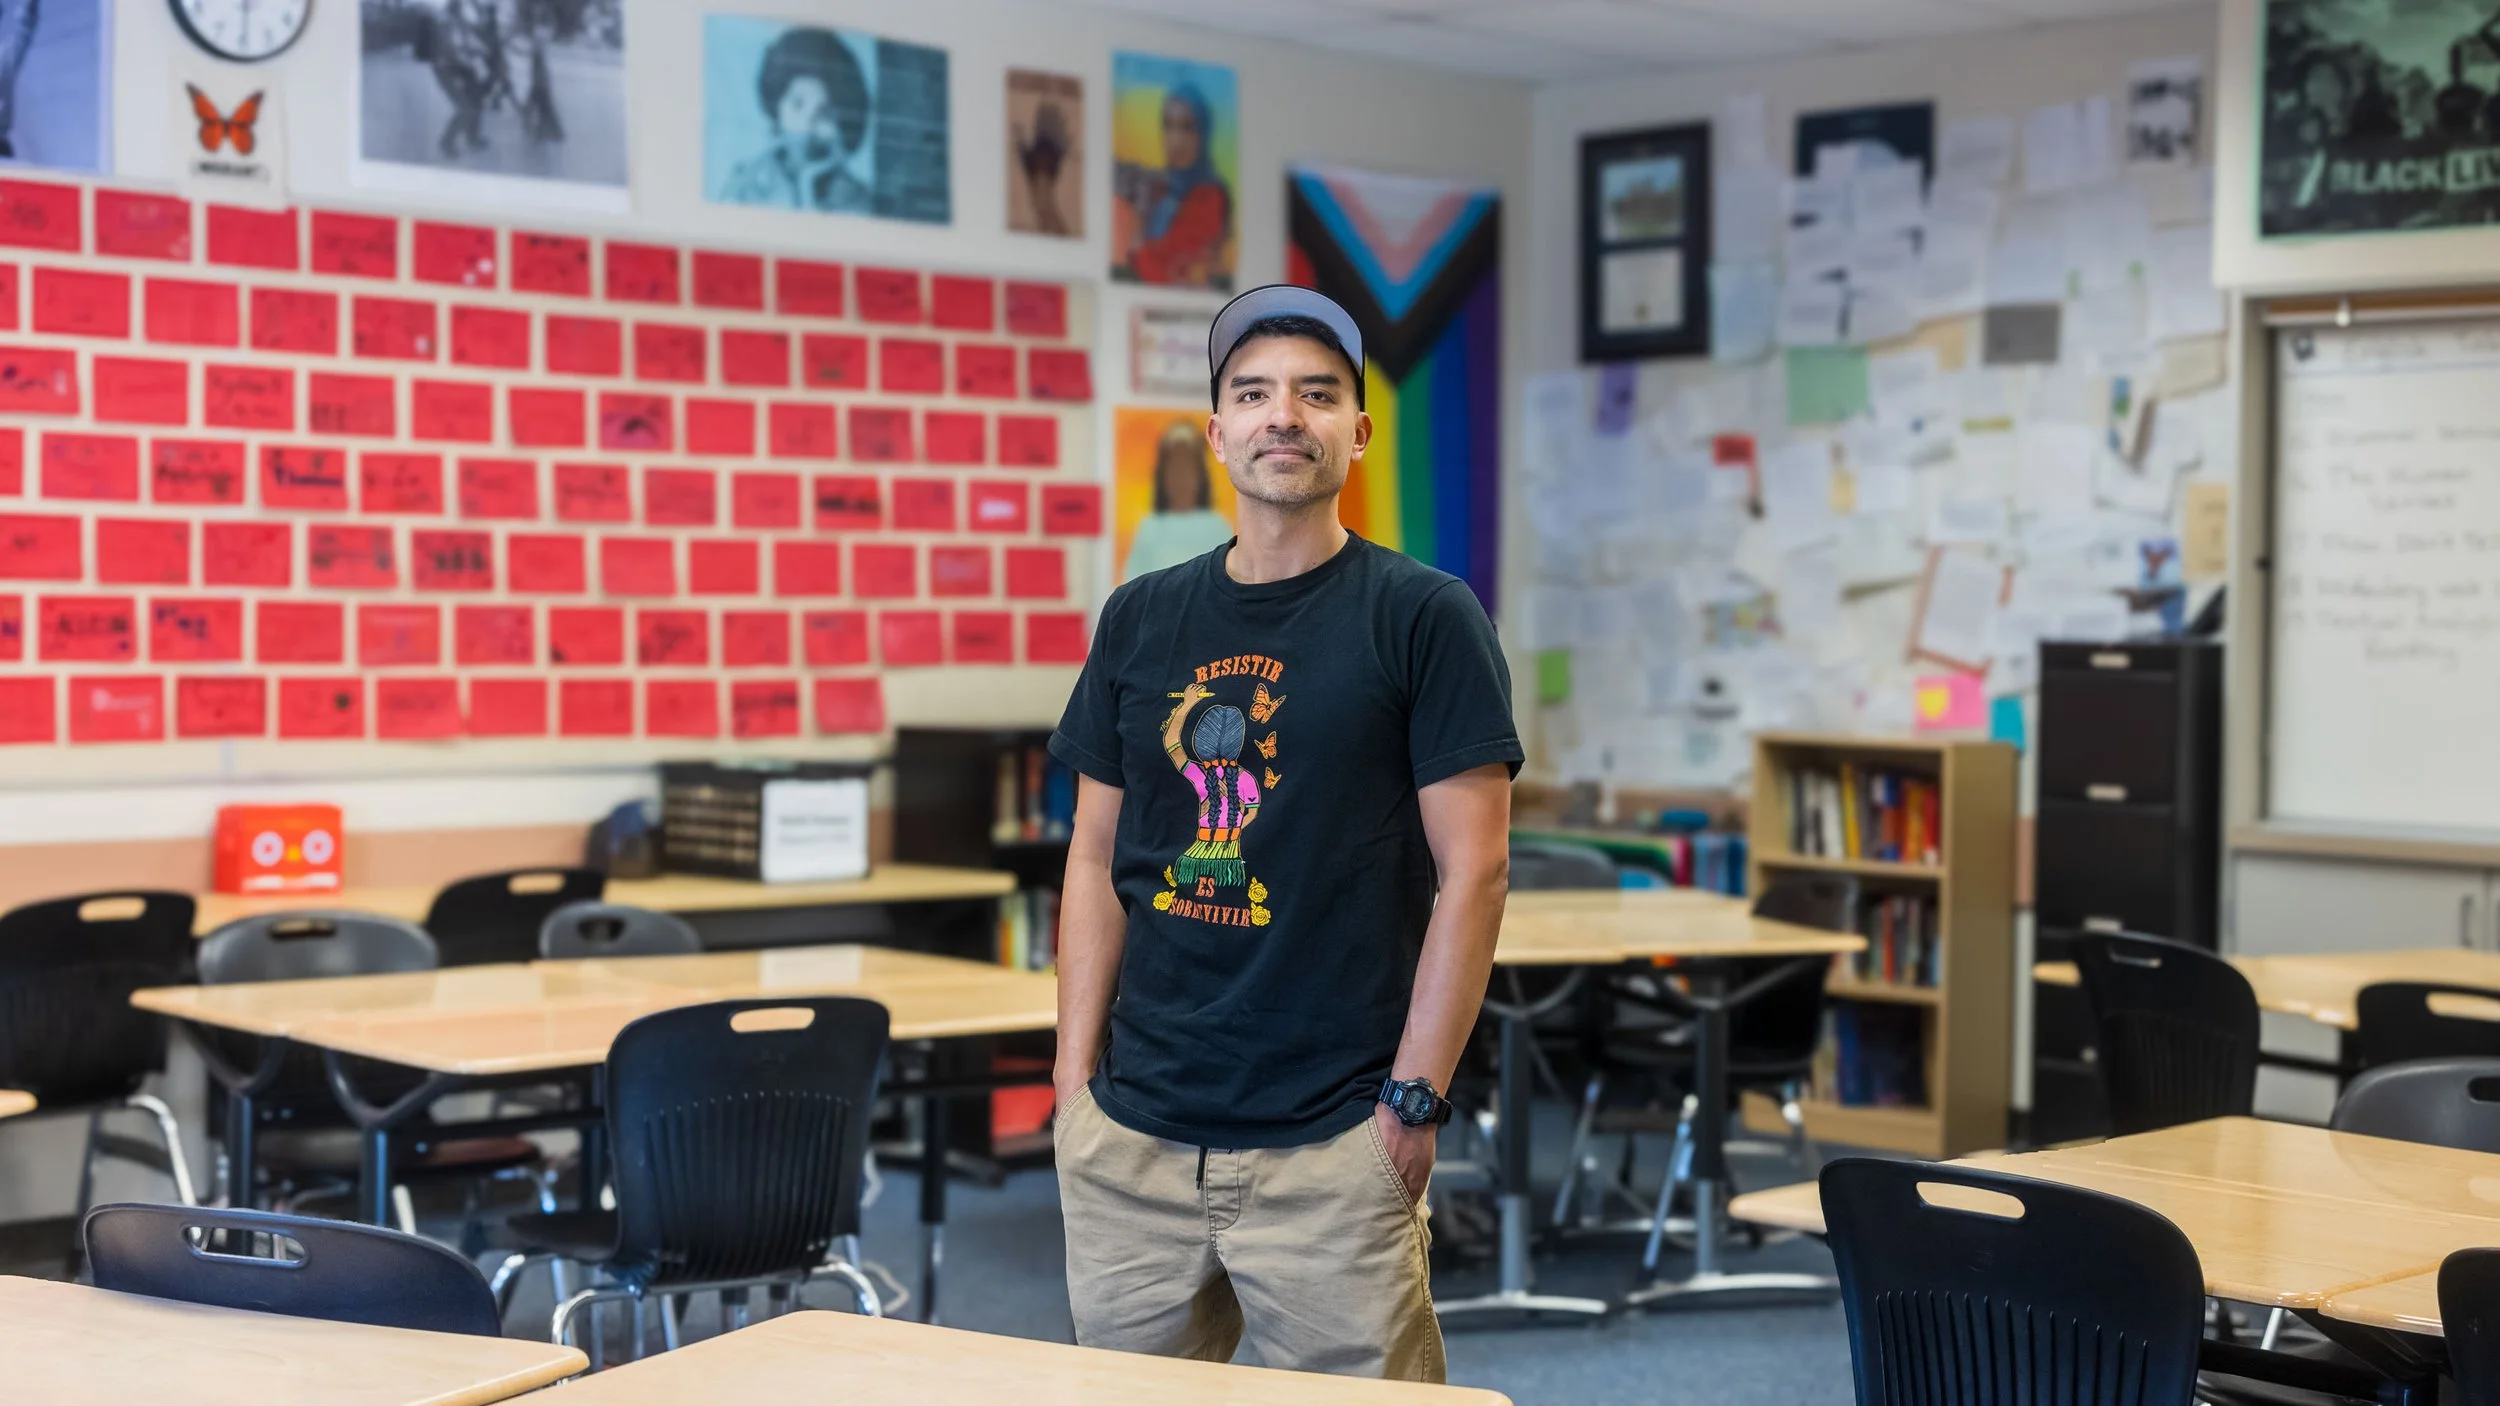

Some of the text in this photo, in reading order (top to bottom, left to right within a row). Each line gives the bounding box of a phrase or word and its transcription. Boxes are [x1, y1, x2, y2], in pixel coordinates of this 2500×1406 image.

[2330, 158, 2442, 193] BLACK
[1194, 654, 1284, 684] RESISTIR
[1195, 876, 1215, 898] ES
